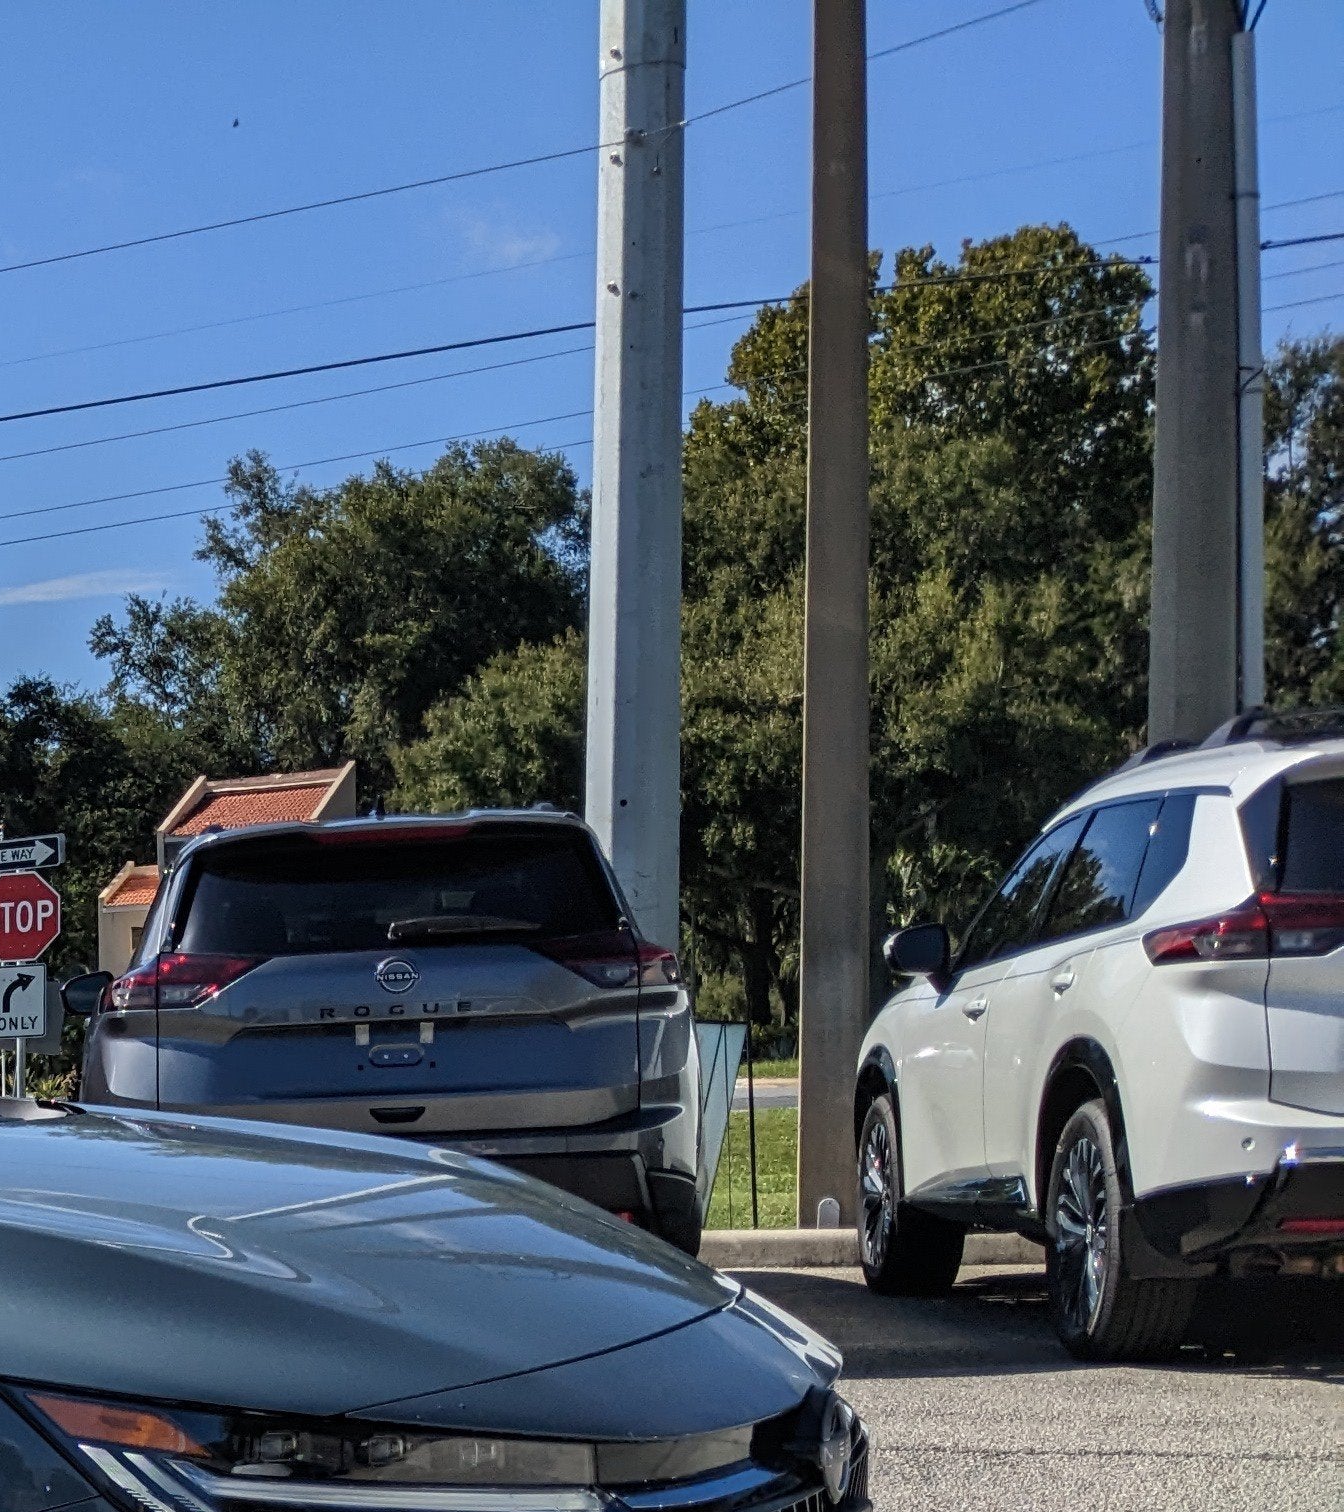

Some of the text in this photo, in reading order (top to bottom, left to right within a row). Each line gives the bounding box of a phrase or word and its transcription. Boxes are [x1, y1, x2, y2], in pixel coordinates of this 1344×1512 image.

[11, 848, 35, 860] WAY
[377, 973, 419, 981] NISSAN
[320, 1001, 472, 1018] ROGUE
